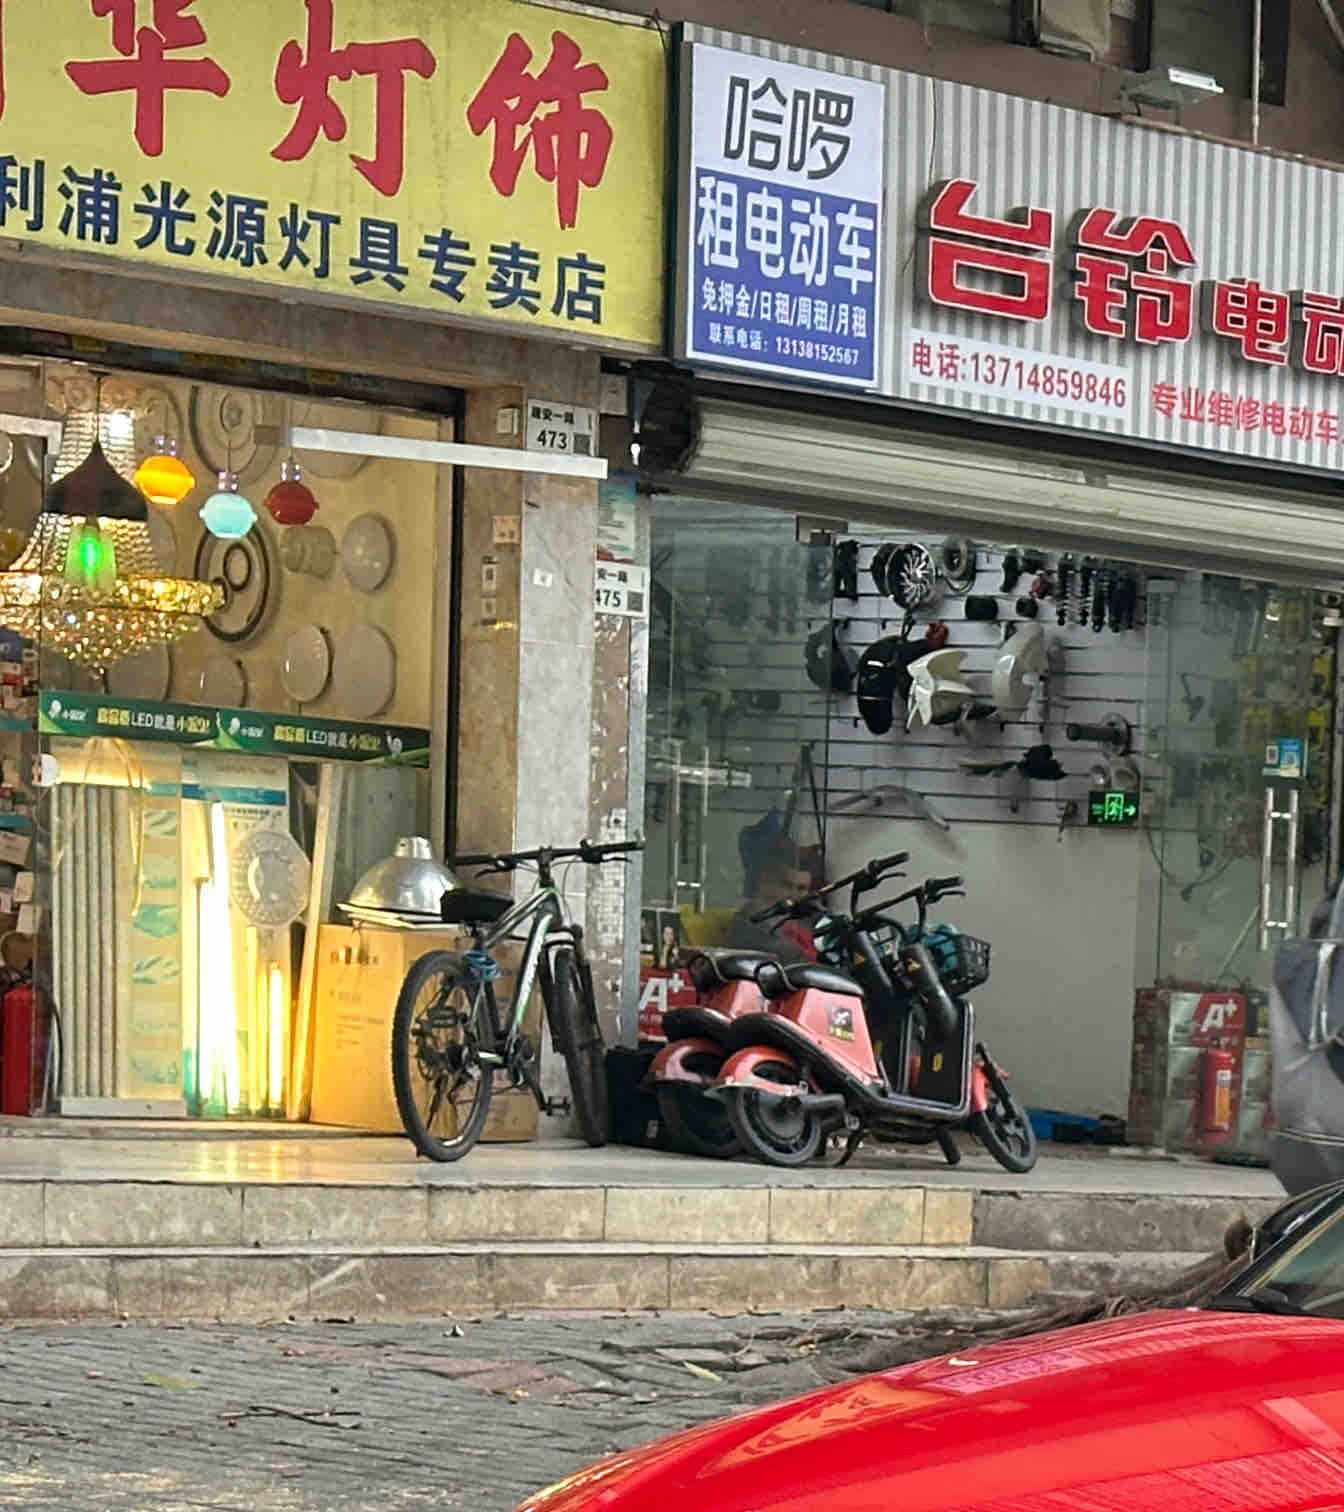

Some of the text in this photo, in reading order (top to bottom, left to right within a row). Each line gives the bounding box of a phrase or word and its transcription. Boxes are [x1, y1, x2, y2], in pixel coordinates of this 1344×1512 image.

[0, 0, 614, 230] 华灯饰
[723, 75, 855, 180] 哈啰
[0, 153, 607, 325] 利浦光源灯具专卖店
[697, 176, 875, 295] 租电动车
[702, 276, 868, 338] 免押金/日租/周租/月租
[537, 430, 568, 449] 473
